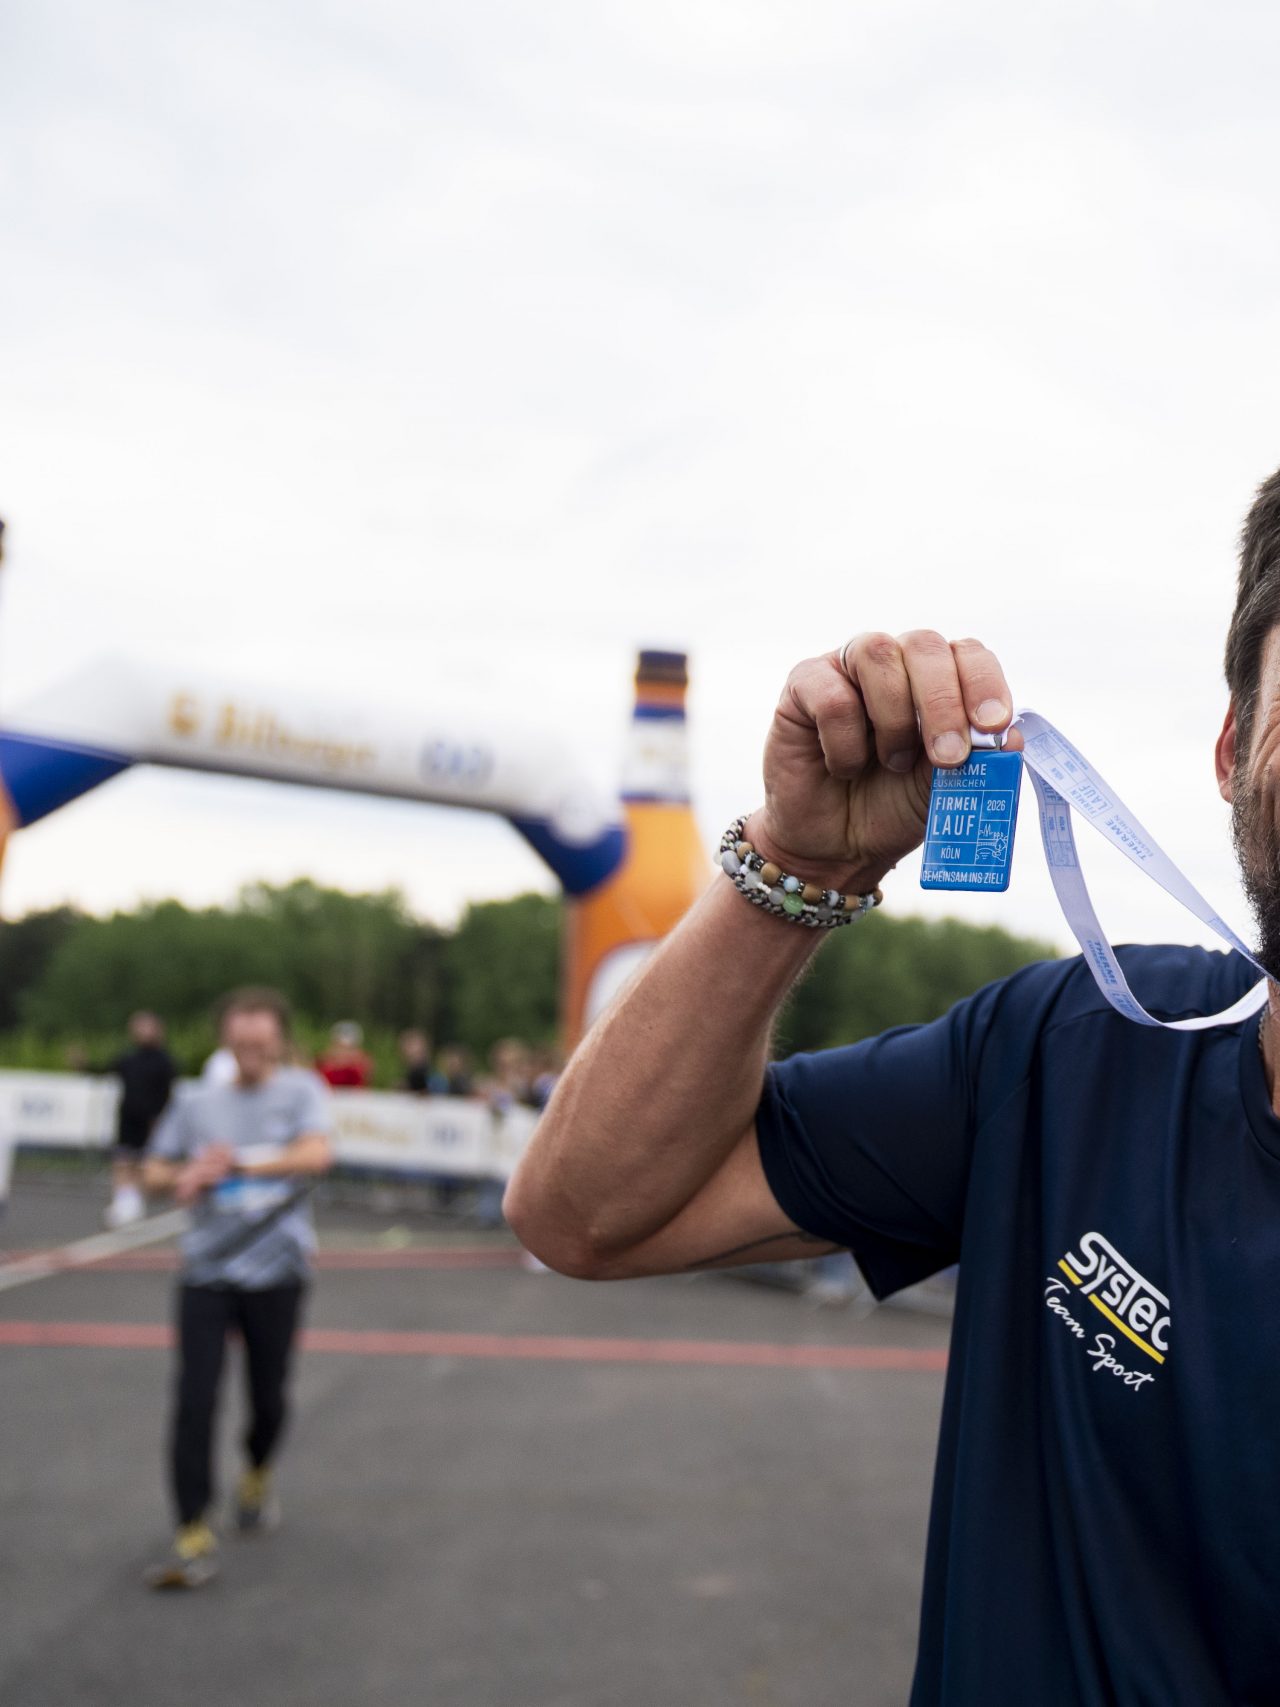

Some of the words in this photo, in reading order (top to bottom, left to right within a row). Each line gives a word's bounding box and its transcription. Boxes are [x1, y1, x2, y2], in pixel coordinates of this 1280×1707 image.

[933, 779, 986, 788] EUSKIRCHEN
[935, 796, 978, 811] FIRMEN
[986, 799, 1006, 812] 2026
[1078, 785, 1108, 812] LAUF
[932, 815, 976, 836] LAUF
[1105, 818, 1147, 860] THERME
[940, 845, 961, 860] KÖLN
[922, 870, 968, 882] GEMEINSAM
[968, 872, 983, 884] INS
[983, 872, 1004, 885] ZIEL!
[1094, 941, 1118, 985] THERME
[1044, 1277, 1085, 1339] Team
[1086, 1333, 1155, 1392] Sport
